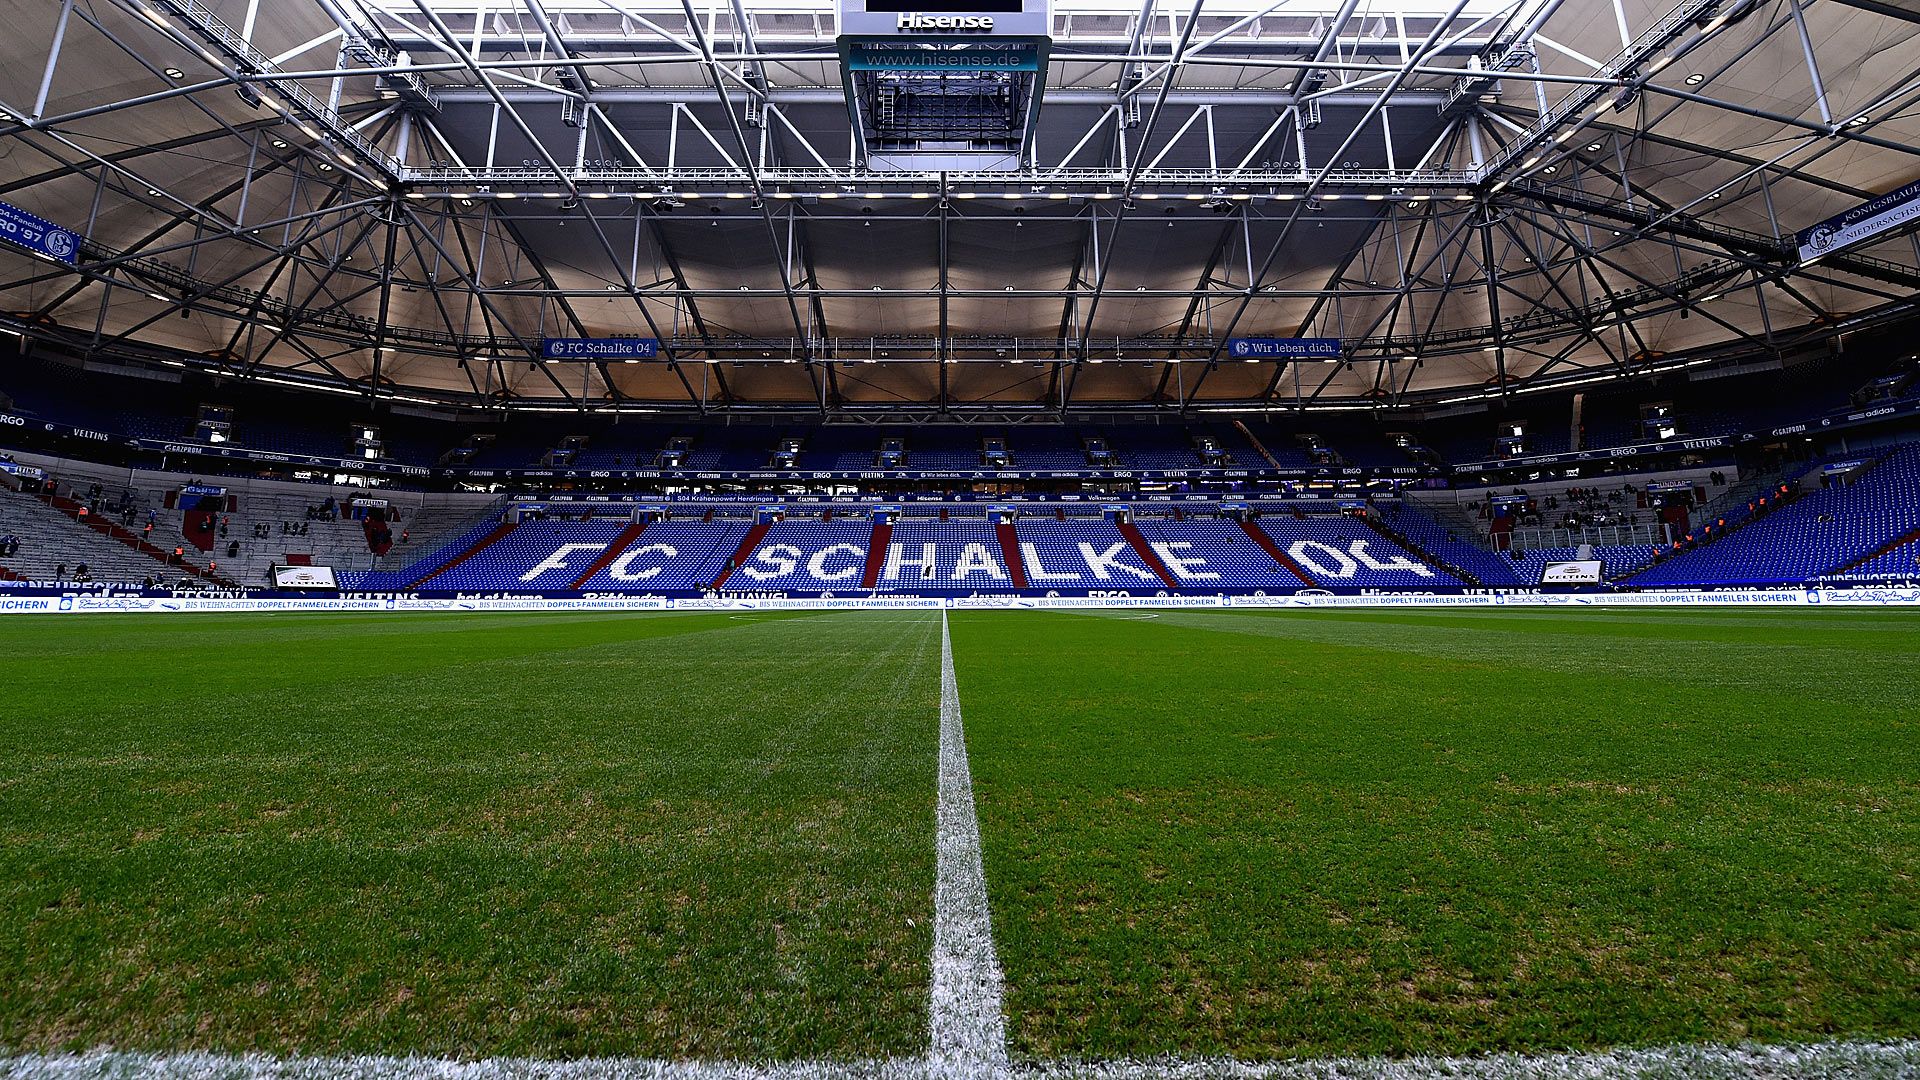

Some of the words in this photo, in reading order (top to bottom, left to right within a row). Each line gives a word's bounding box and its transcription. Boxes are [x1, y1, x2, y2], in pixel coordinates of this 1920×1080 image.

[897, 12, 993, 29] Hisense
[866, 53, 1020, 66] www.hisense.de
[567, 343, 583, 353] FC
[586, 343, 633, 353] Schalke
[636, 343, 650, 353] 04
[1251, 343, 1272, 353] Wir
[1275, 343, 1305, 353] leben
[1309, 343, 1336, 353] dich.
[1610, 448, 1637, 456] ERGO
[1683, 438, 1722, 449] VELTINS
[1865, 406, 1895, 418] adidas
[73, 428, 109, 441] VELTINS
[340, 461, 365, 469] ERGO
[401, 467, 430, 475] VELTINS
[518, 543, 677, 582] FC
[743, 541, 1220, 581] SCHALKE
[1287, 540, 1435, 579] 04
[1752, 594, 1797, 602] SICHERN
